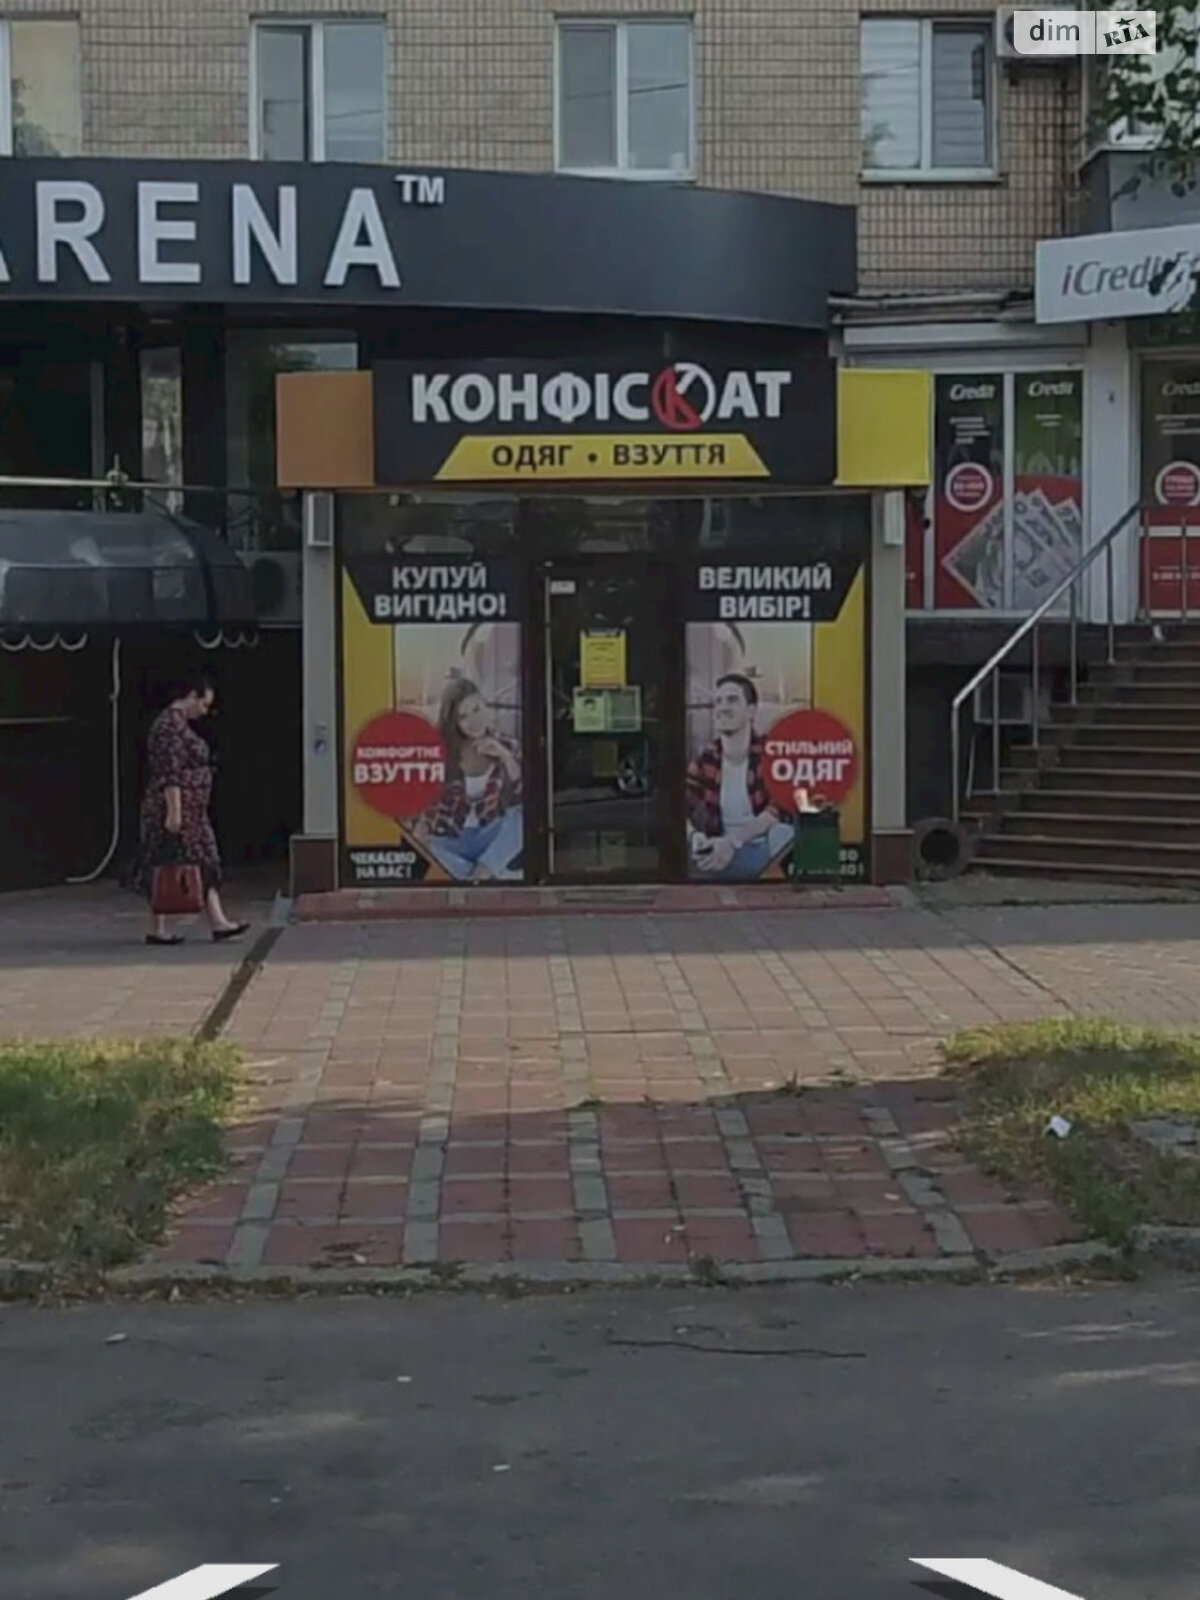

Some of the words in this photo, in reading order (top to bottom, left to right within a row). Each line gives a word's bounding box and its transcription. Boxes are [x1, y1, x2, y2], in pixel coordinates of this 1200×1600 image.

[0, 179, 402, 288] RENA
[394, 174, 445, 204] TM
[411, 362, 792, 431] КОНФІСКАТ
[950, 383, 996, 401] Credit
[1028, 381, 1074, 398] Credit
[492, 445, 572, 473] ОДЯГ
[613, 443, 725, 466] ВЗУТТЯ
[392, 563, 487, 590] КУПУЙ
[698, 563, 832, 591] ВЕЛИКИЙ
[374, 593, 507, 621] ВИГІДНО!
[719, 595, 812, 620] ВИБІР!
[356, 746, 441, 759] КОМФОРТНЕ
[764, 739, 853, 756] СТИЛЬНИЙ
[354, 761, 445, 784] ВЗУТТЯ
[770, 758, 851, 786] ОДЯГ
